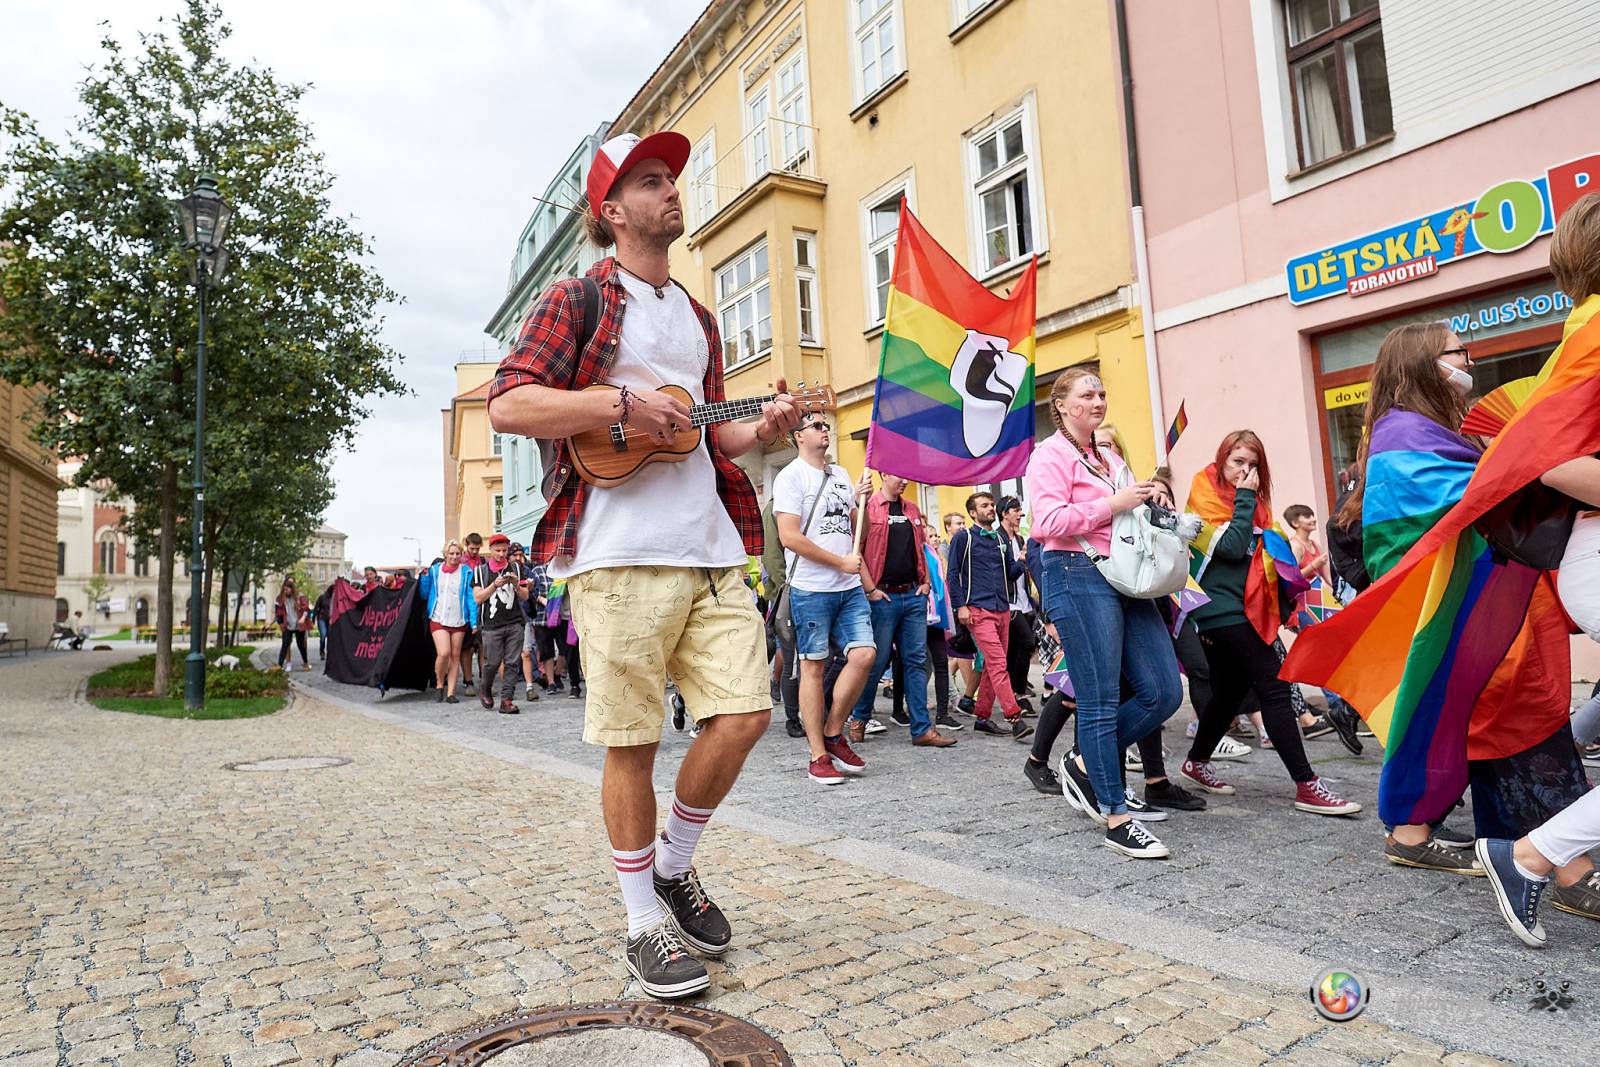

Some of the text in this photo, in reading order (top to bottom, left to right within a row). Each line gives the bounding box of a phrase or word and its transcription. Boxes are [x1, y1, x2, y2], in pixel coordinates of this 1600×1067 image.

[1296, 219, 1441, 292] DĚTSKÁ
[1350, 257, 1434, 293] ZDRAVOTNÍ
[1335, 392, 1351, 403] do
